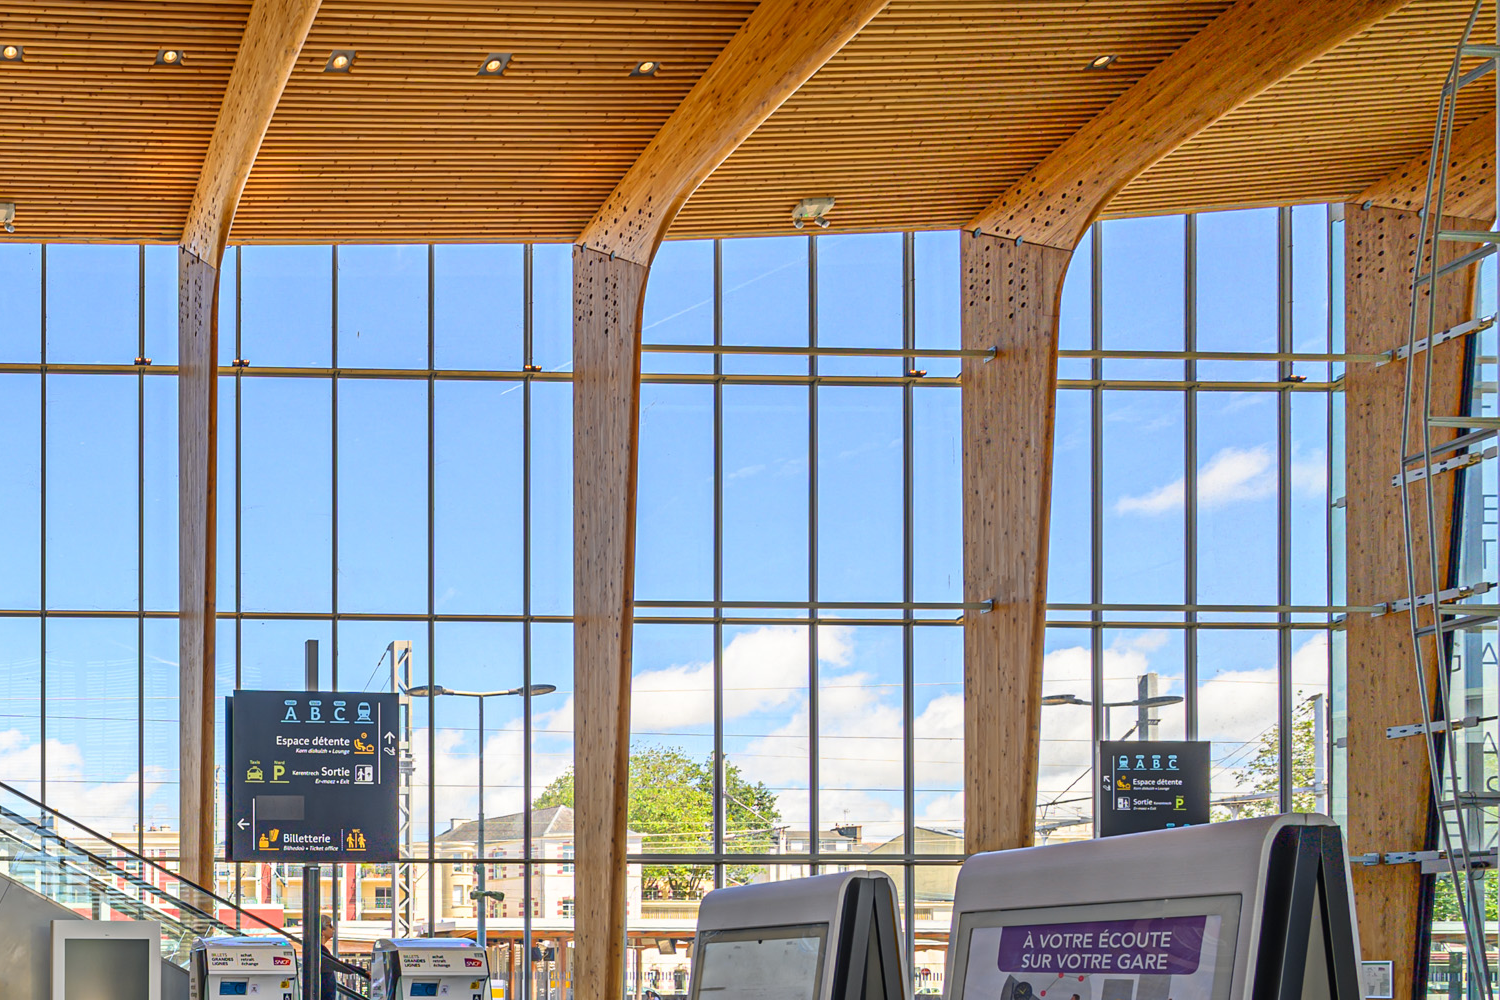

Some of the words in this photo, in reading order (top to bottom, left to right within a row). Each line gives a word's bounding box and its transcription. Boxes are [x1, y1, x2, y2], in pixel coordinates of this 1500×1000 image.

[285, 707, 297, 720] A
[311, 707, 321, 720] B
[334, 707, 345, 721] C
[276, 736, 309, 747] Espace
[312, 736, 350, 746] détente
[1136, 760, 1145, 769] A
[1153, 760, 1160, 769] B
[1168, 760, 1177, 769] C
[274, 765, 285, 780] P
[321, 767, 350, 777] Sortie
[1176, 799, 1184, 809] P
[283, 833, 330, 843] Billetterie
[1023, 931, 1034, 949] À
[1040, 933, 1093, 949] VOTRE
[1098, 929, 1172, 949] ÉCOUTE
[1021, 953, 1052, 969] SUR
[1057, 954, 1112, 969] VOTRE
[1117, 953, 1168, 970] GARE
